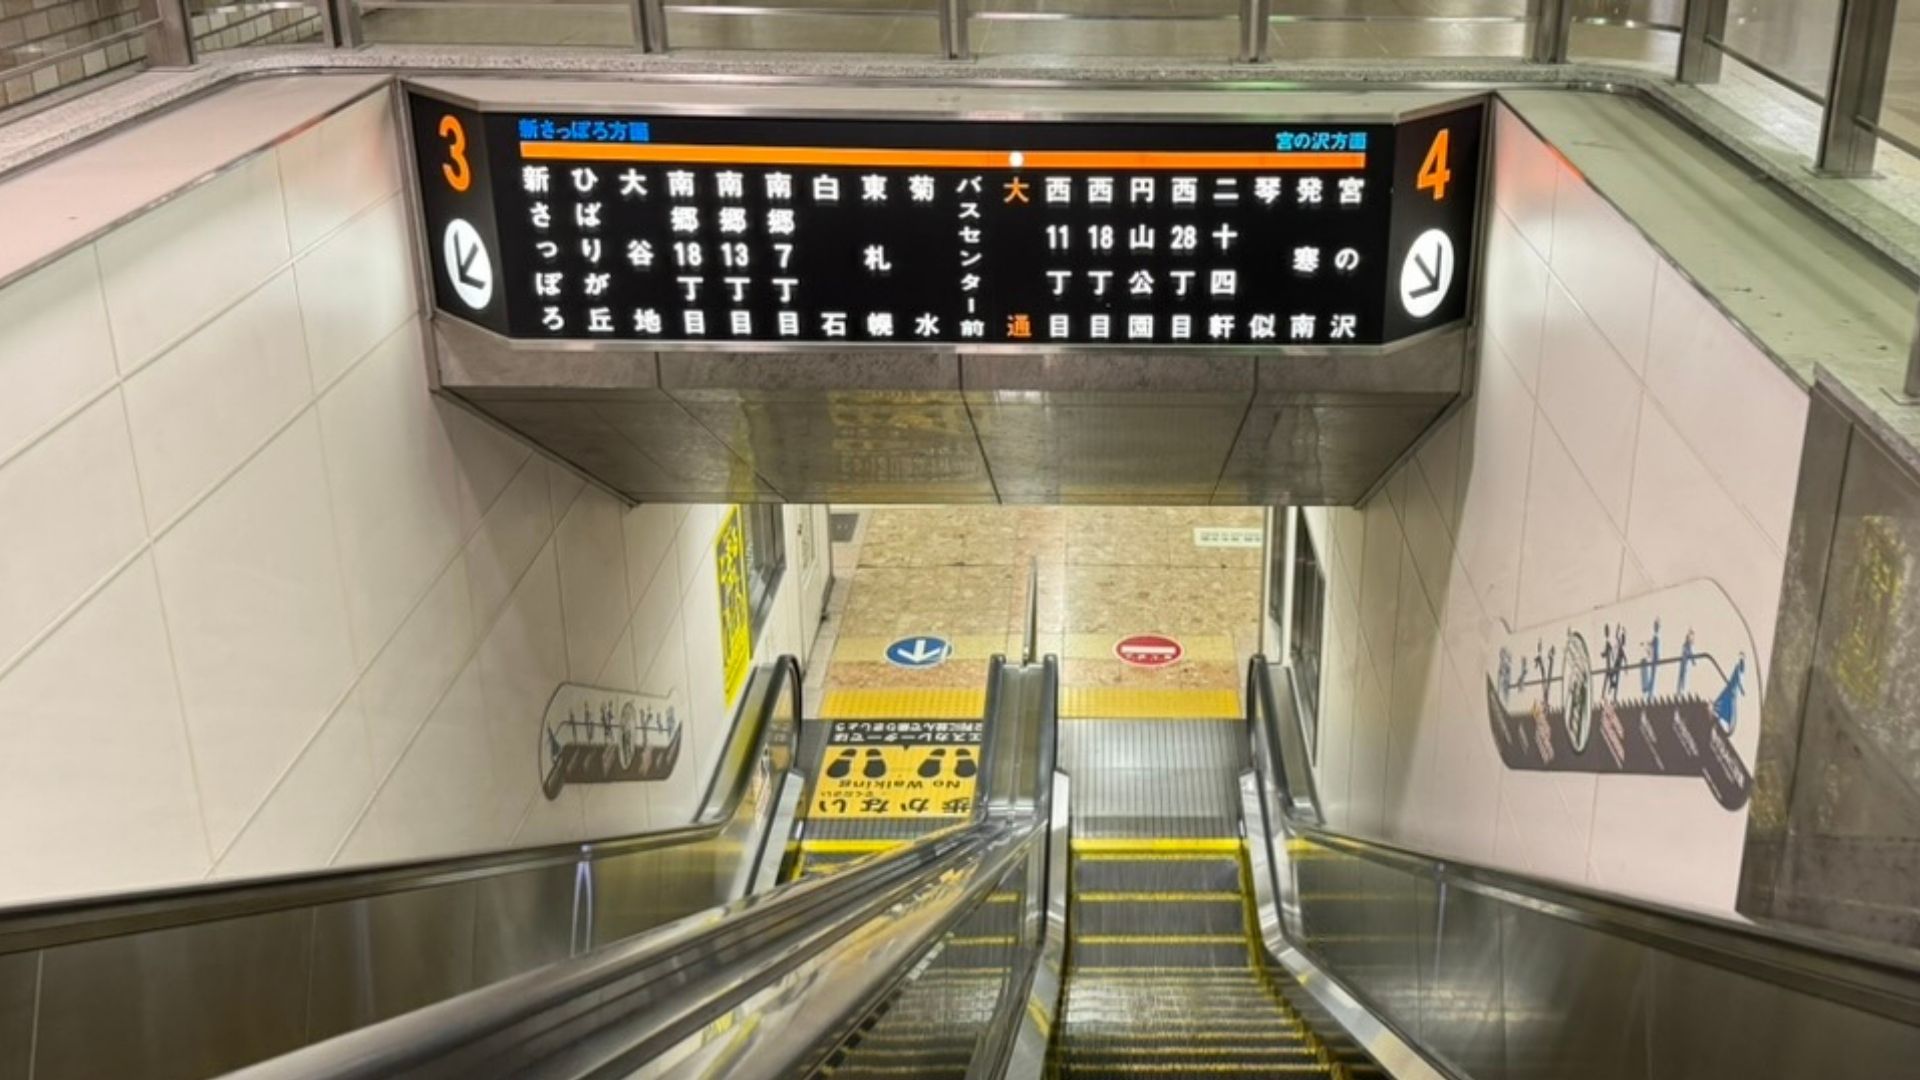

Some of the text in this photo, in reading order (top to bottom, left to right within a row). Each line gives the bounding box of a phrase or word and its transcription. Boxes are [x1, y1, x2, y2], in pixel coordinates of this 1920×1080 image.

[438, 115, 471, 192] 3
[518, 118, 650, 142] 新さっぽろ方面
[1275, 131, 1368, 150] 宮の沢方面
[1416, 129, 1451, 200] 4
[523, 166, 566, 333] 新さっぽろ
[572, 168, 614, 333] ひばりが丘
[620, 169, 661, 333] 大谷地
[667, 170, 704, 333] 南郷18丁目
[716, 171, 751, 334] 南郷13丁目
[765, 172, 798, 334] 南郷7丁目
[813, 174, 846, 336] 白石
[862, 175, 893, 335] 東札幌
[909, 175, 939, 336] 菊水
[957, 177, 984, 336] バスセンター前
[1005, 178, 1030, 336] 大通
[1046, 177, 1071, 337] 西11丁目
[1088, 177, 1113, 337] 西18丁目
[1129, 178, 1154, 338] 円山公園
[1171, 178, 1197, 337] 西28丁目
[1210, 179, 1238, 338] 二十四軒
[1250, 177, 1280, 338] 琴似
[1291, 178, 1322, 338] 発寒南
[1331, 177, 1364, 337] 宮の沢
[818, 797, 971, 815] 歩かない
[838, 779, 961, 790] No Walking
